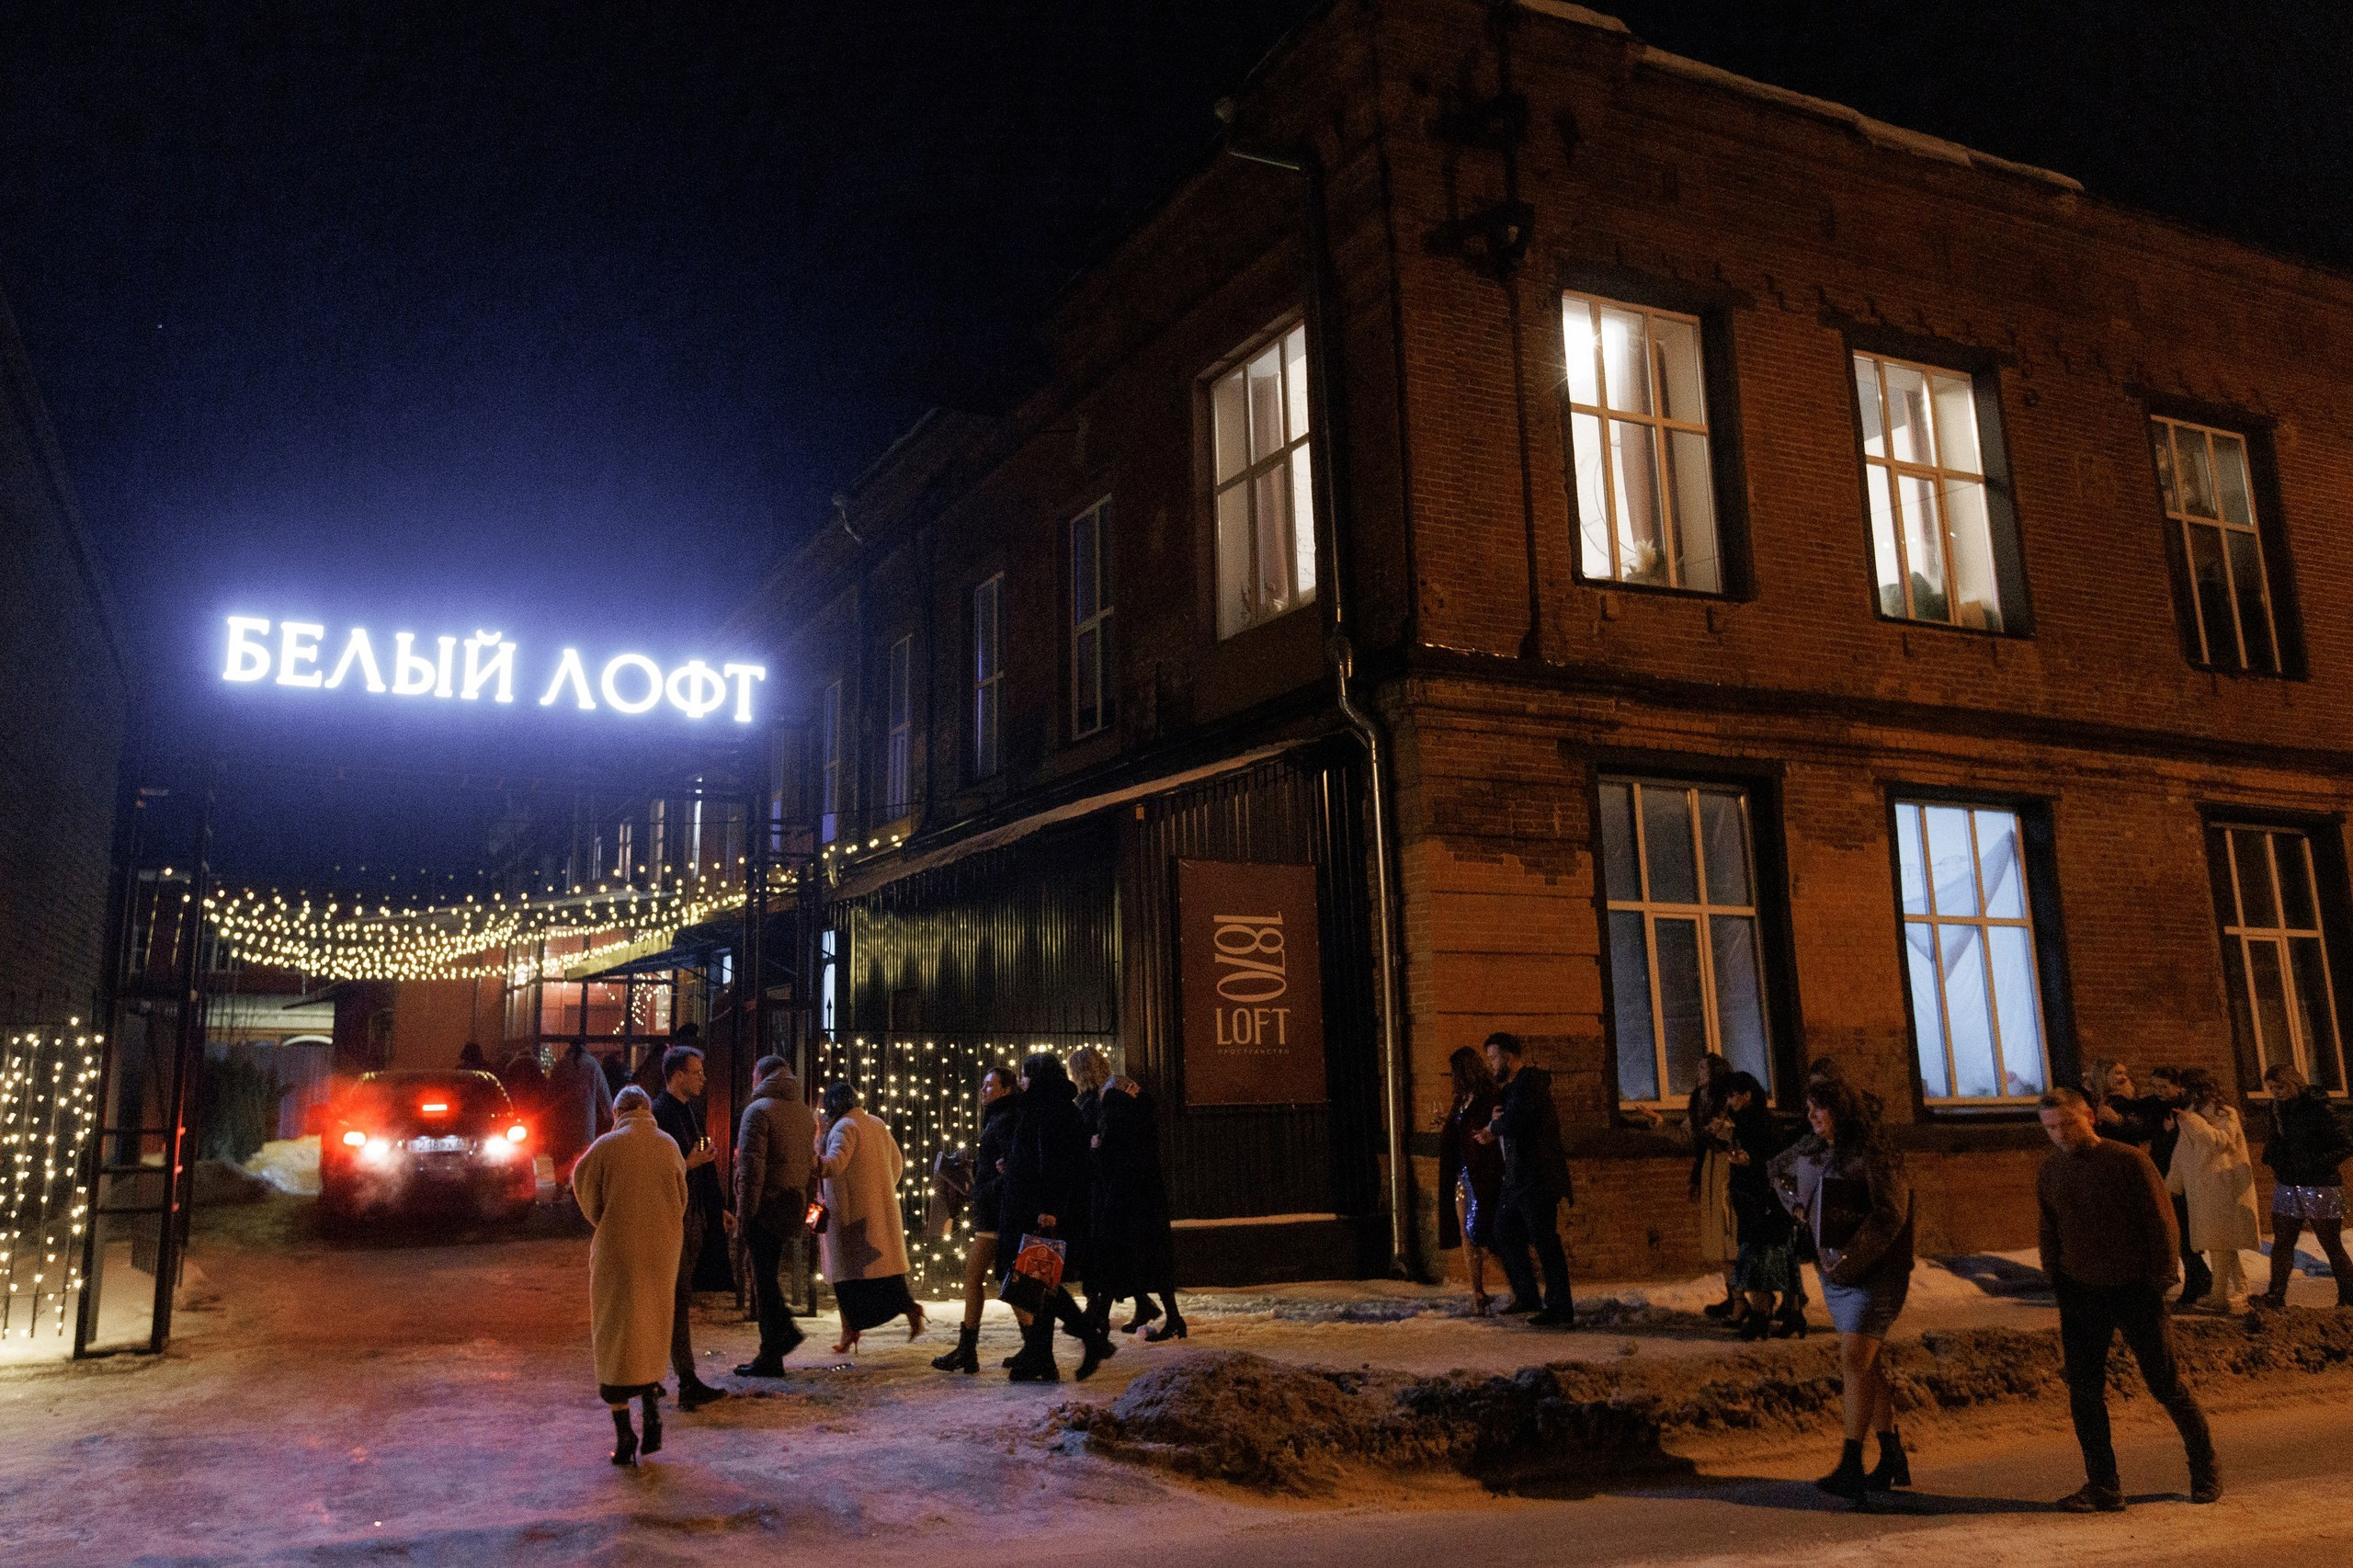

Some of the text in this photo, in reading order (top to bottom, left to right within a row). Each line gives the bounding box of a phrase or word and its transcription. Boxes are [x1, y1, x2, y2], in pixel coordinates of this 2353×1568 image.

[222, 616, 766, 722] БЕЛЫЙ ЛОФТ
[1213, 911, 1287, 1003] 1870
[1216, 1008, 1290, 1045] LOFT
